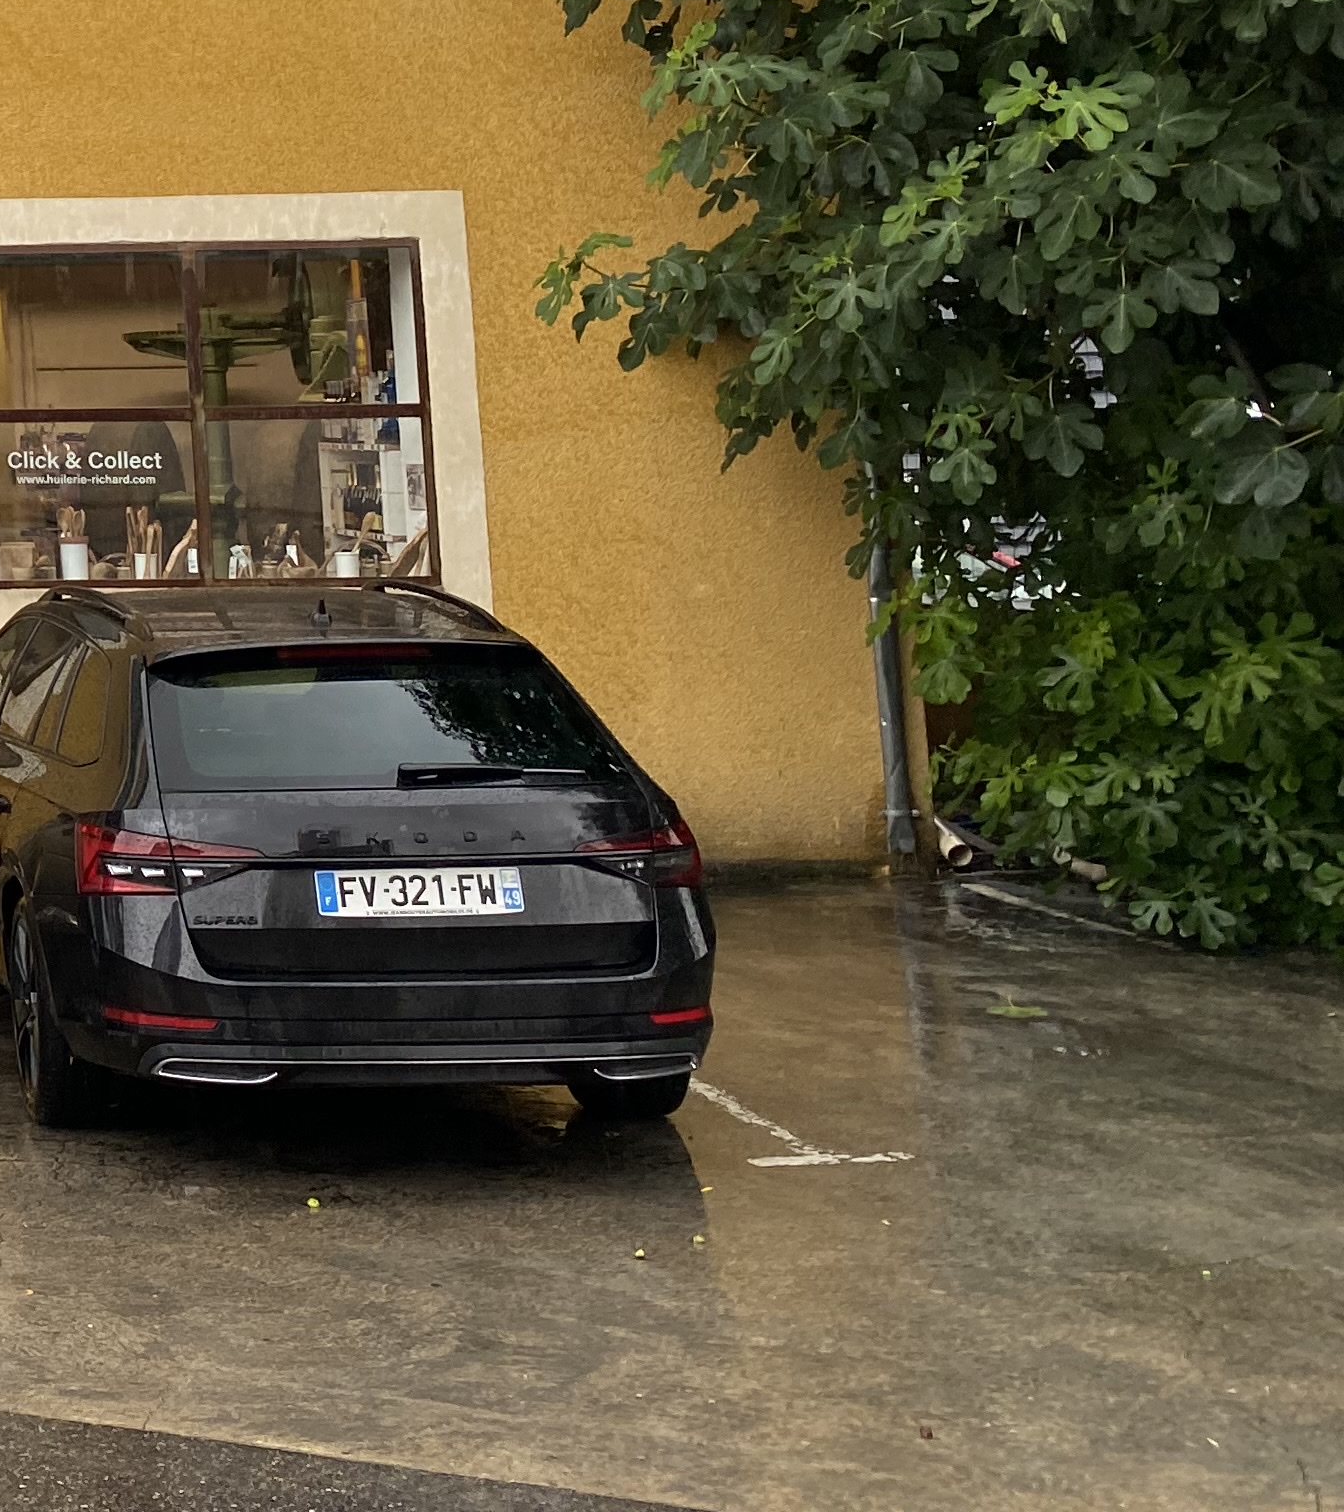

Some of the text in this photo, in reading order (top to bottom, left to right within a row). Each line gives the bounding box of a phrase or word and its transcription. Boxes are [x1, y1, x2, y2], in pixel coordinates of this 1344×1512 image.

[7, 450, 162, 469] Click & Collect
[16, 473, 156, 485] www.huilerie-richard.com
[338, 874, 497, 908] FV-321-FW
[505, 889, 521, 906] 49
